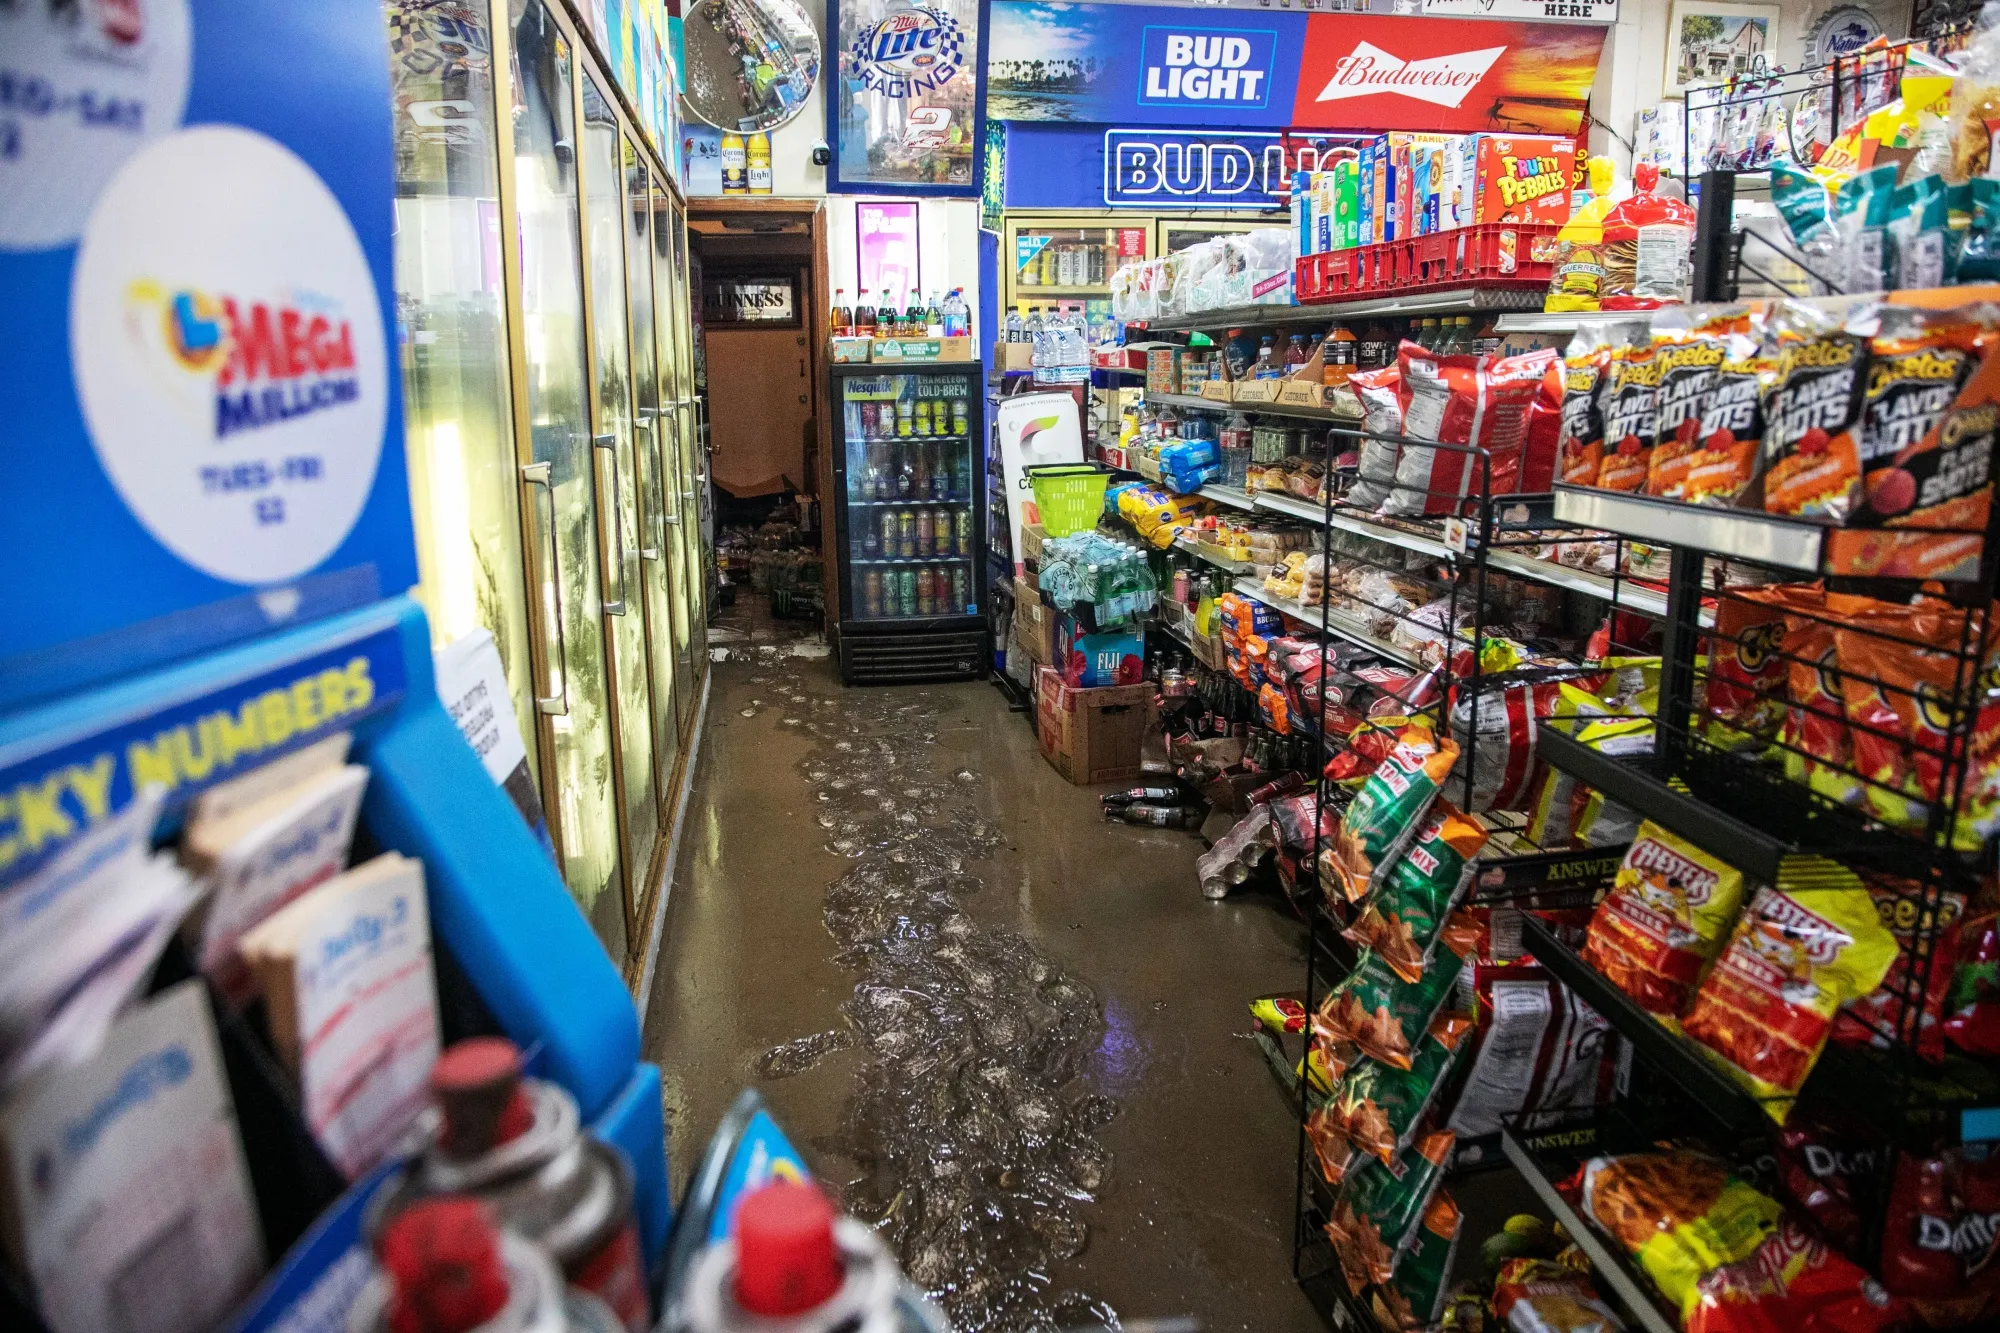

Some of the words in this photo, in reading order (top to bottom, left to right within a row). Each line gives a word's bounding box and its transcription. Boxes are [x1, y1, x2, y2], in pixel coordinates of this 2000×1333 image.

[1545, 4, 1593, 18] HERE
[873, 26, 944, 63] Lite
[1165, 34, 1252, 69] BUD
[857, 61, 957, 99] RACING
[1336, 53, 1484, 88] Budweiser
[1145, 67, 1263, 101] LIGHT
[1417, 135, 1448, 144] FAMILY
[1494, 141, 1512, 152] Post
[750, 170, 770, 180] Light
[1116, 142, 1254, 195] BUD
[1501, 155, 1559, 178] FRUITY
[1496, 170, 1567, 208] PEBBLES
[847, 379, 892, 397] Nesquik
[917, 375, 968, 384] CHAMELEON
[918, 384, 968, 397] COLD-BREW
[1241, 391, 1264, 400] GATORADE
[1284, 391, 1309, 402] GATORADE
[1097, 652, 1120, 670] FIJI
[127, 654, 375, 792] NUMBERS
[1095, 767, 1137, 780] ARROWHEAD
[1410, 848, 1437, 876] MIX
[1619, 901, 1665, 932] FRIES
